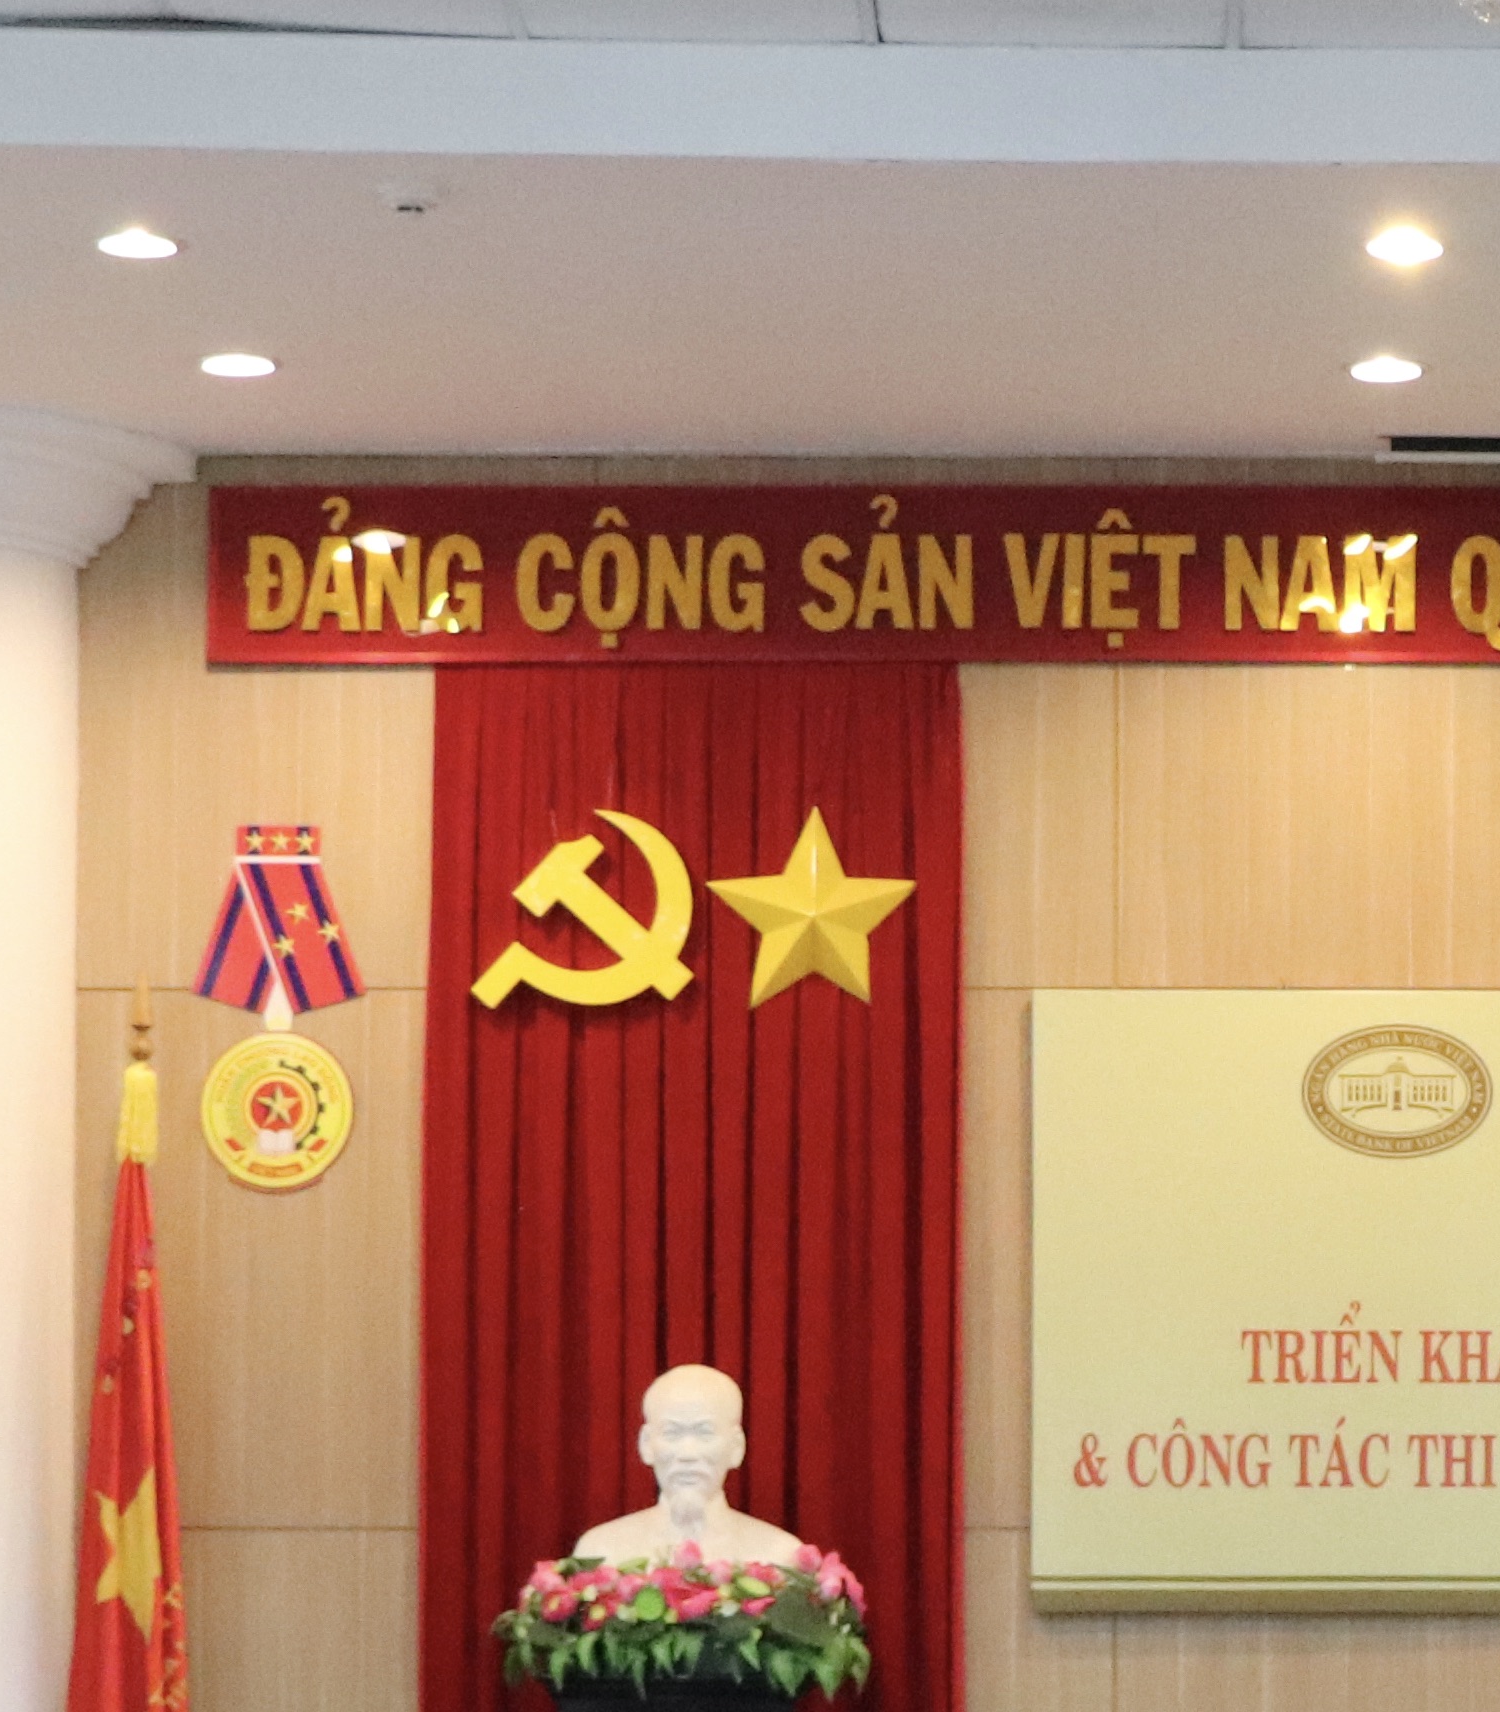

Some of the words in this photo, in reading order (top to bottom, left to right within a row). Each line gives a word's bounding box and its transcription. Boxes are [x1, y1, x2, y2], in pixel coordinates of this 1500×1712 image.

[244, 497, 483, 637] ĐẢNG
[516, 508, 764, 647] CỘNG
[801, 495, 972, 631] SẢN
[1004, 510, 1195, 646] VIỆT
[1225, 532, 1418, 644] NAM
[1241, 1302, 1401, 1383] TRIỂN
[1074, 1432, 1109, 1487] &
[1126, 1419, 1270, 1487] CÔNG
[1288, 1418, 1390, 1488] TÁC
[1408, 1432, 1498, 1488] THI
